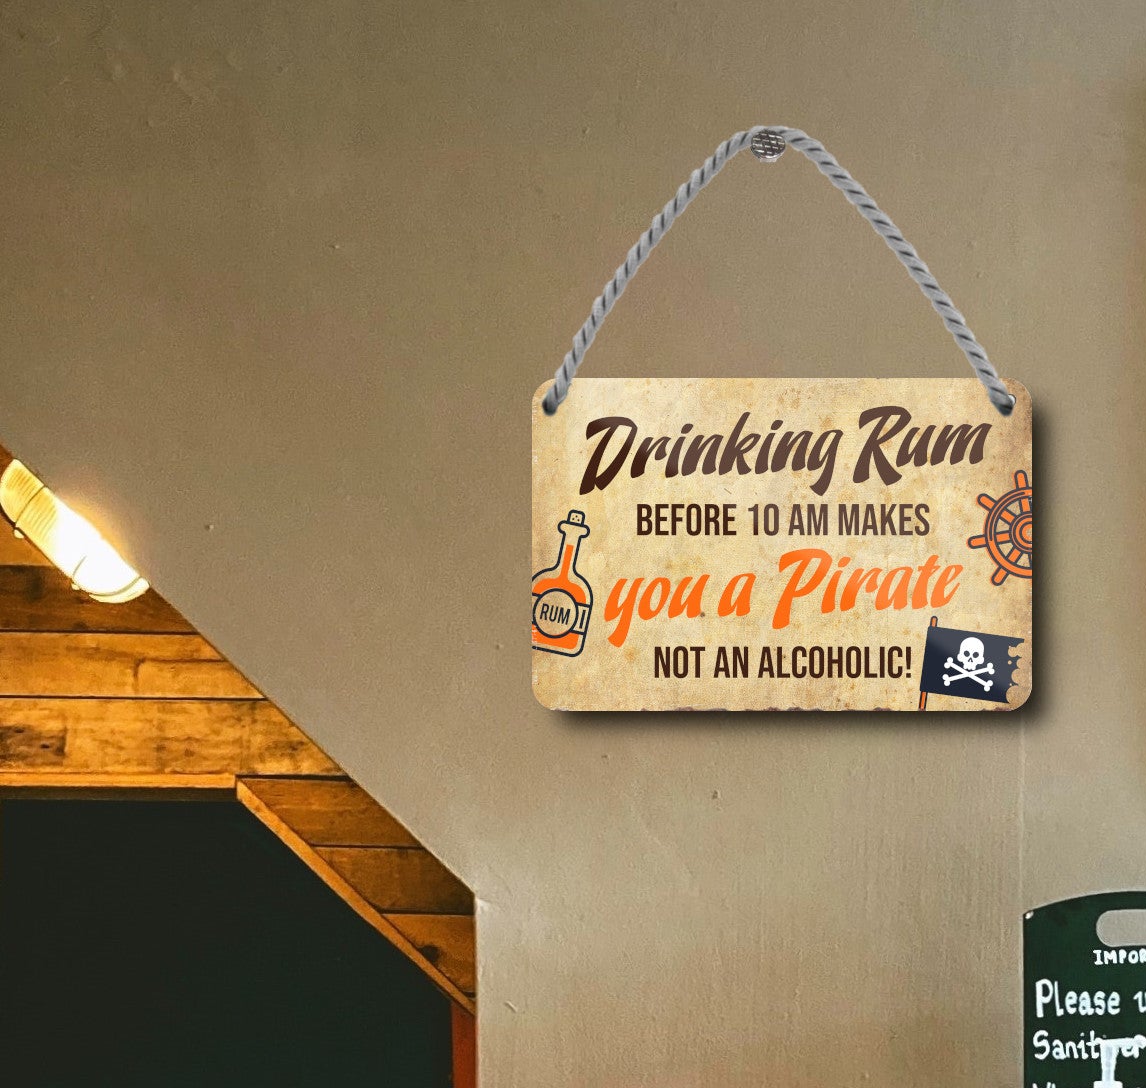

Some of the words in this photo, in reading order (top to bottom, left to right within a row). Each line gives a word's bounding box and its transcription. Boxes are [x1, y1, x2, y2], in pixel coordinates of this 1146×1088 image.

[579, 411, 844, 497] Drinking
[853, 405, 993, 486] Rum
[636, 503, 737, 537] BEFORE
[747, 503, 780, 537] 10
[788, 503, 829, 536] AM
[838, 503, 930, 537] MAKES
[539, 602, 571, 626] RUM
[603, 573, 710, 648] you
[717, 572, 757, 617] a
[771, 548, 964, 630] Pirate
[654, 645, 706, 679] NOT
[713, 645, 749, 679] AN
[757, 645, 912, 679] ALCOHOLIC!
[1035, 978, 1121, 1018] Please
